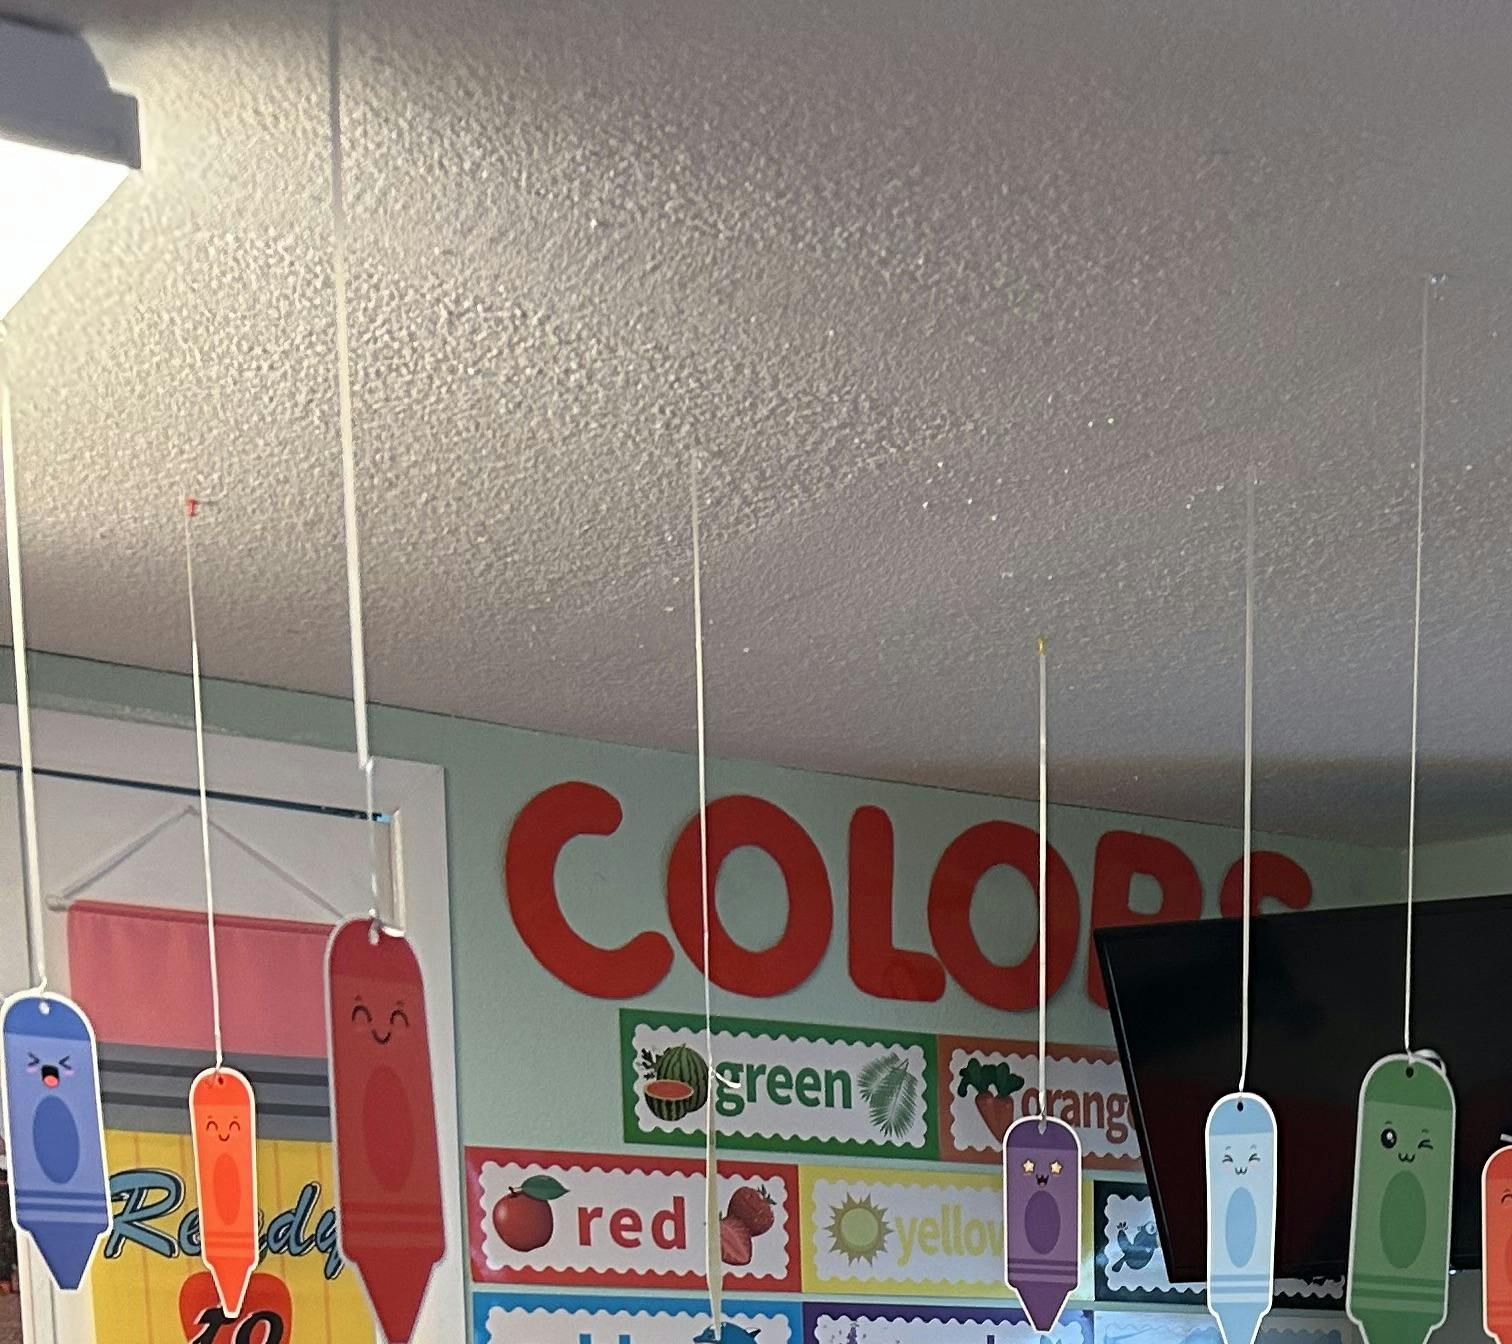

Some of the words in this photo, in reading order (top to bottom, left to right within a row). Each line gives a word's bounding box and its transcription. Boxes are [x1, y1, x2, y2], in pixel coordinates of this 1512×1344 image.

[715, 1058, 853, 1118] green
[1021, 1087, 1136, 1145] orang
[103, 1167, 345, 1281] Redy
[576, 1197, 689, 1250] red
